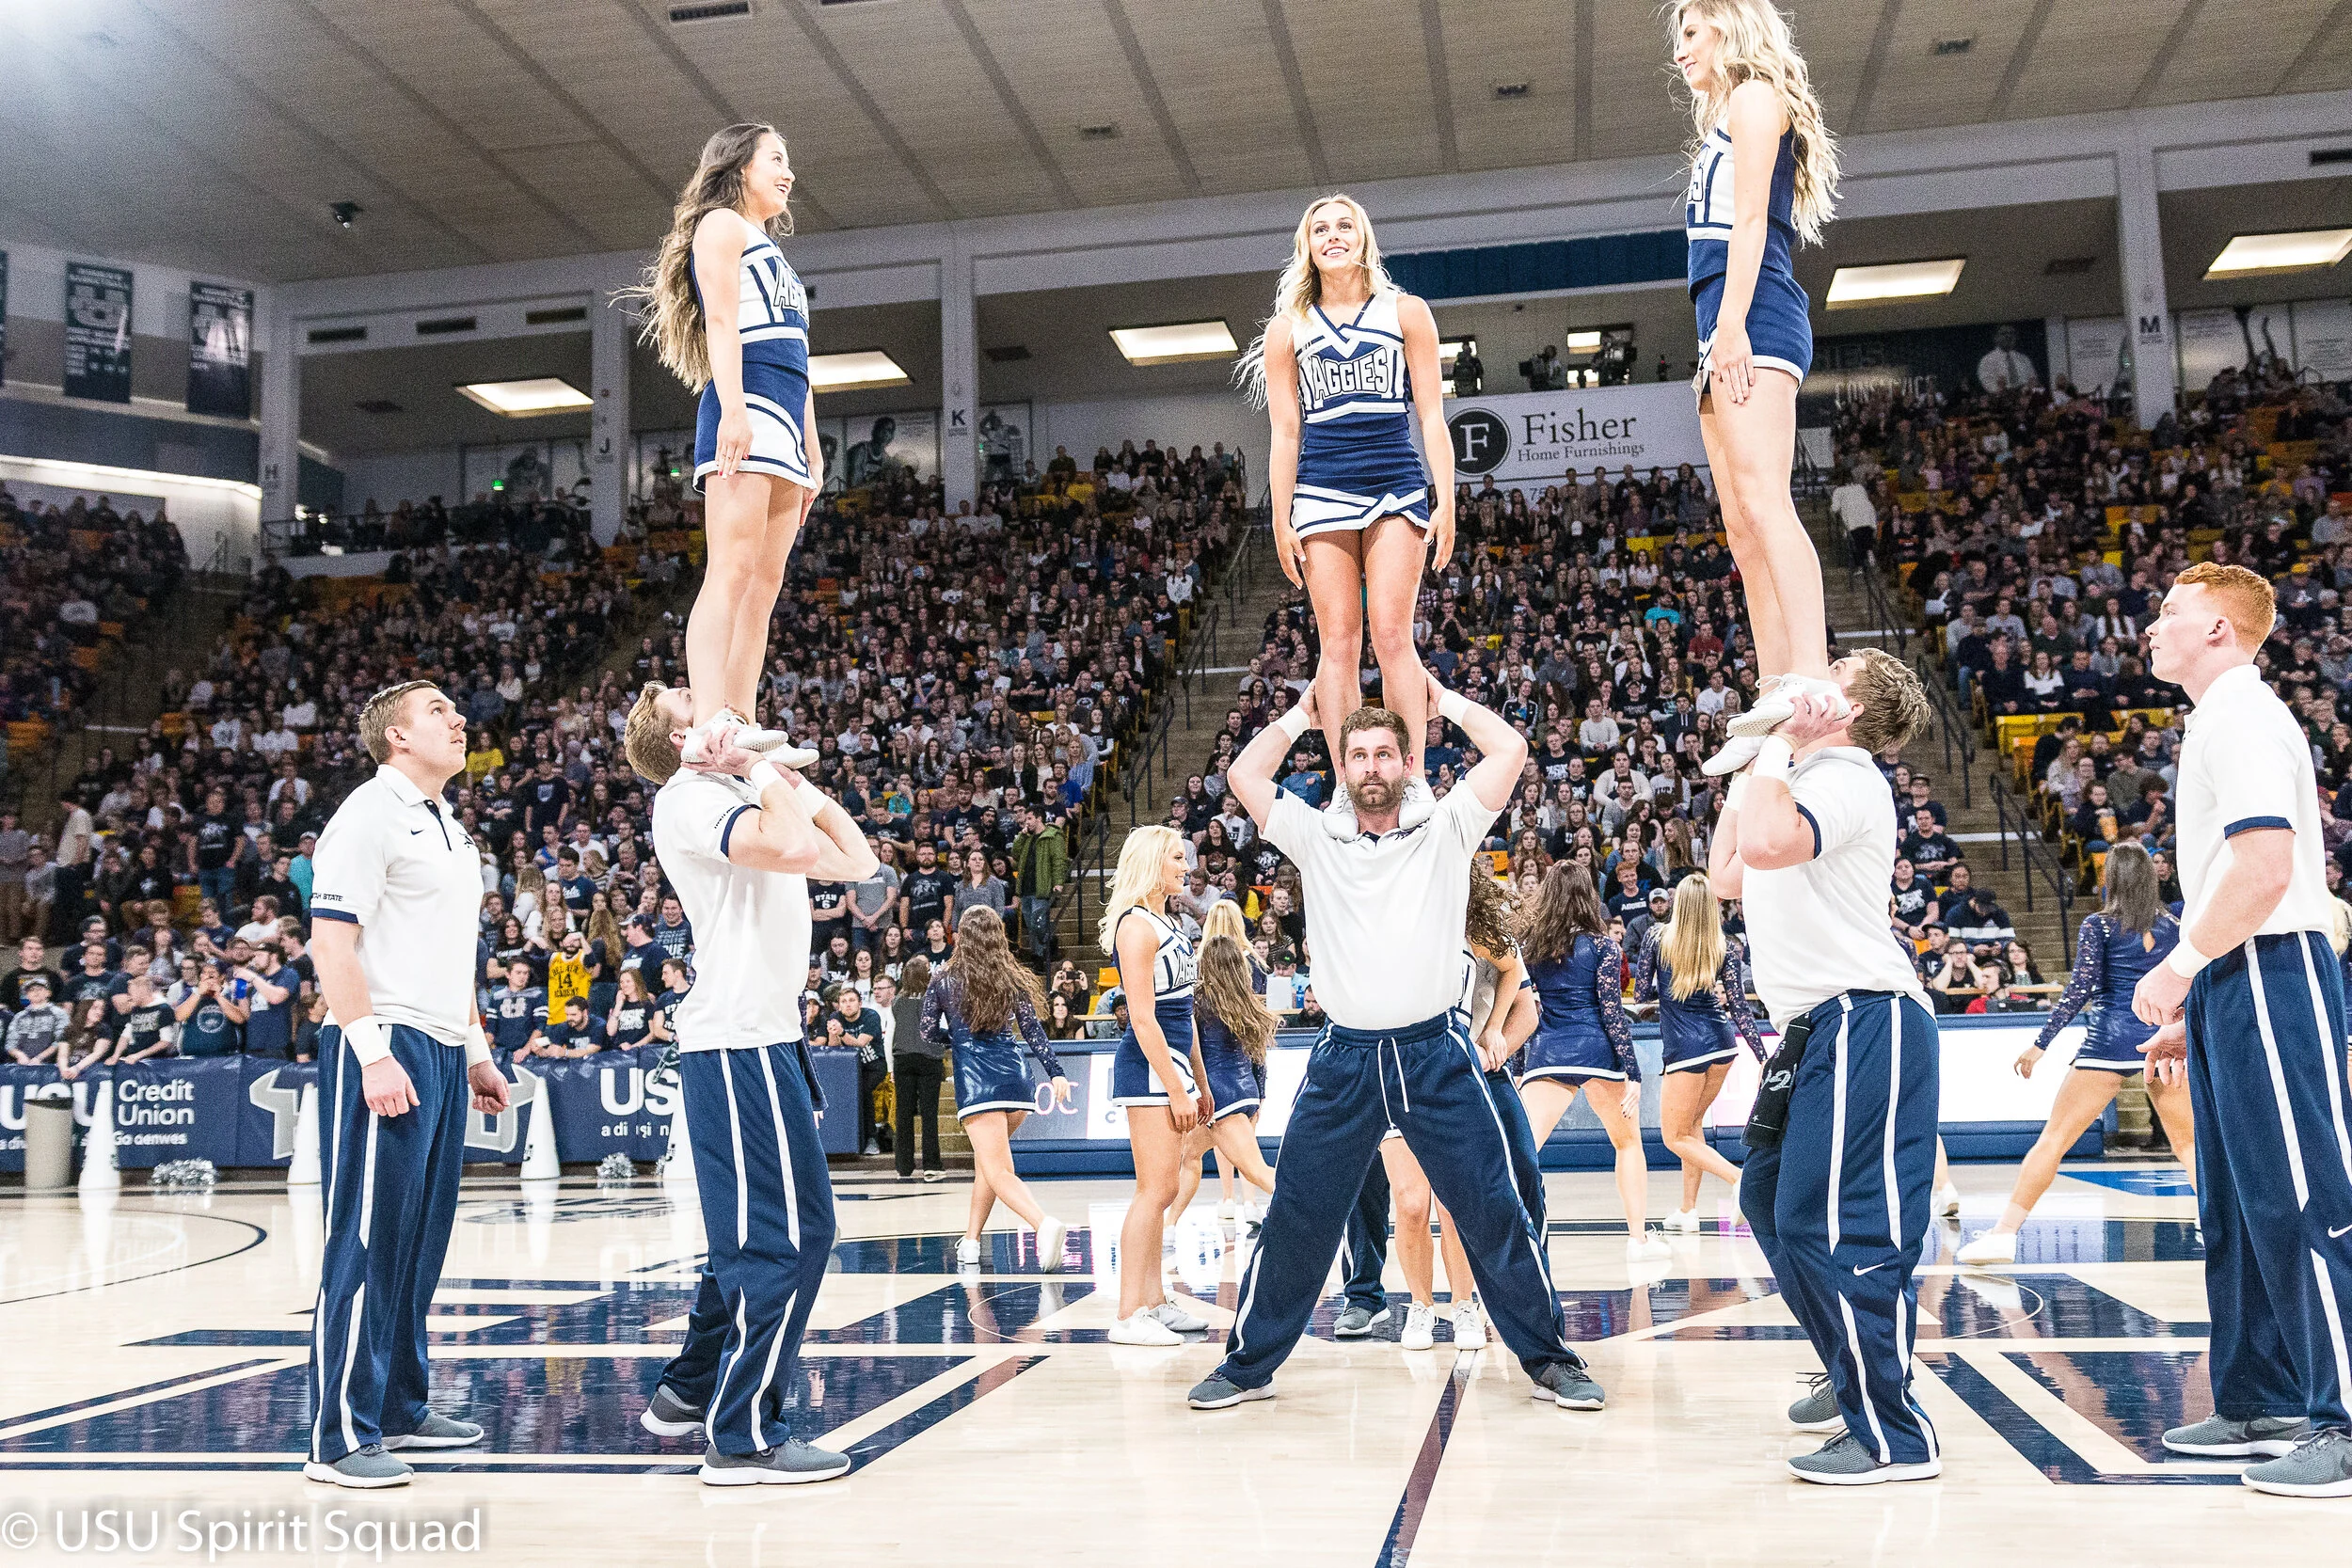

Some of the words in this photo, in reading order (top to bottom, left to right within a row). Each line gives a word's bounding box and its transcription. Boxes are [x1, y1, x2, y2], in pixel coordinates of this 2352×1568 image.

[2140, 315, 2160, 333] M
[1311, 345, 1389, 402] AGGIES
[952, 408, 965, 426] K
[1521, 407, 1637, 446] Fisher
[599, 437, 611, 453] J
[1460, 423, 1489, 462] F
[1518, 449, 1560, 462] Home
[1564, 442, 1645, 459] Furnishings
[323, 893, 342, 901] STATE
[822, 900, 831, 909] 6
[558, 973, 573, 989] 14
[119, 1079, 195, 1102] Credit
[600, 1068, 680, 1116] US
[118, 1104, 195, 1126] Union
